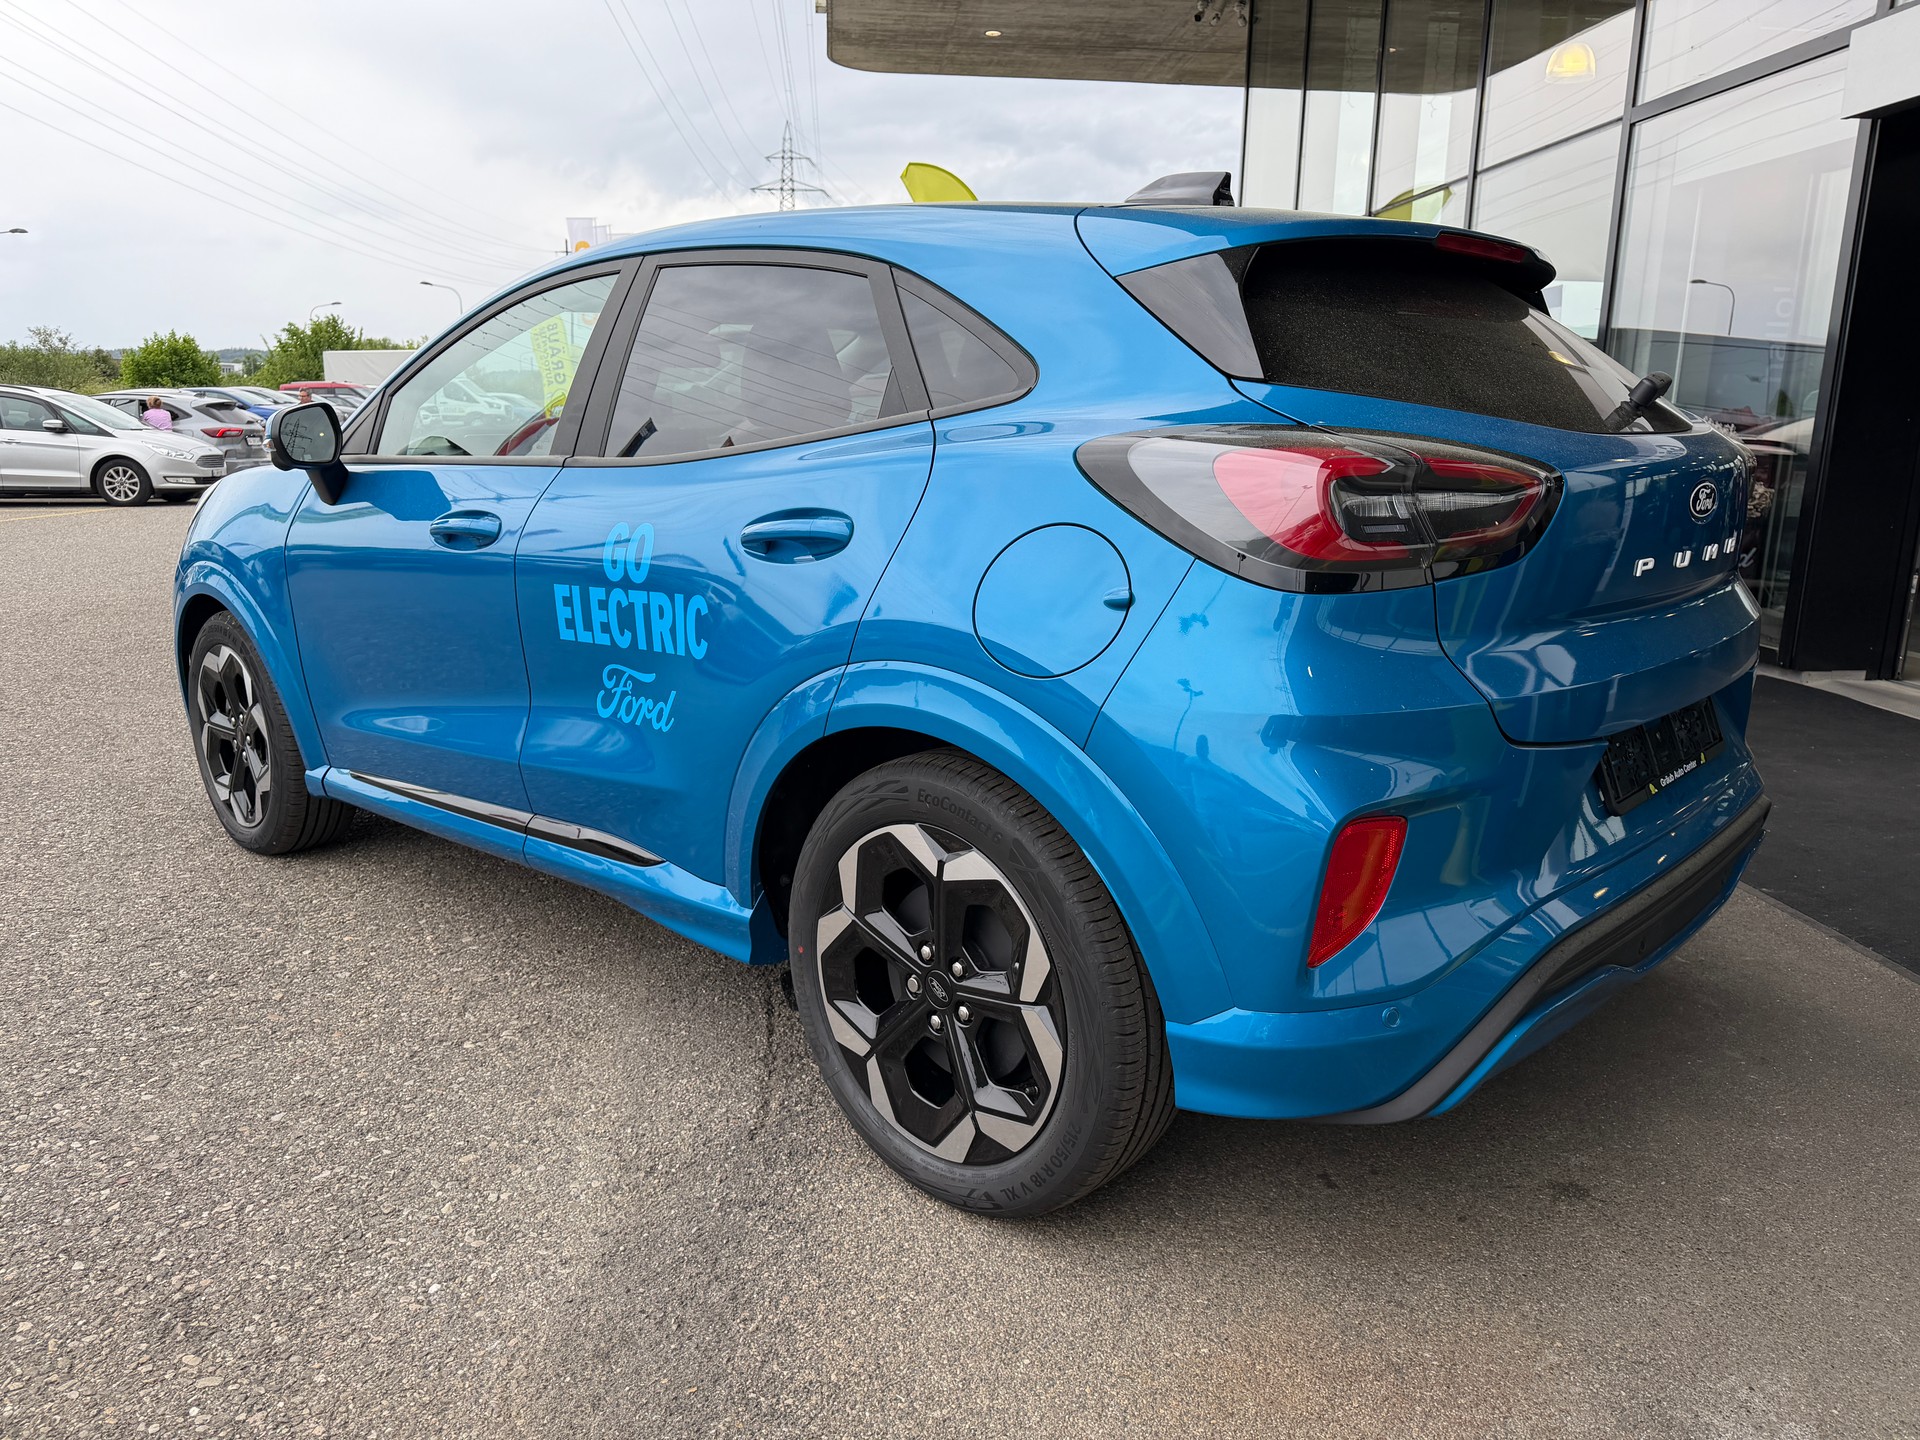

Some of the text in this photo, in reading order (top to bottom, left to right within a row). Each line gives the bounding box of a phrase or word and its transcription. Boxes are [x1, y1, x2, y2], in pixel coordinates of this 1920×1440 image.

[603, 522, 655, 584] GO
[1633, 537, 1736, 577] PUMA
[553, 583, 709, 660] ELECTRIC
[596, 663, 677, 733] Ford
[1674, 768, 1685, 780] Auto
[1683, 760, 1698, 773] Center
[918, 788, 993, 838] EcoContact
[1000, 1122, 1082, 1202] 215/50 R 18 V XL
